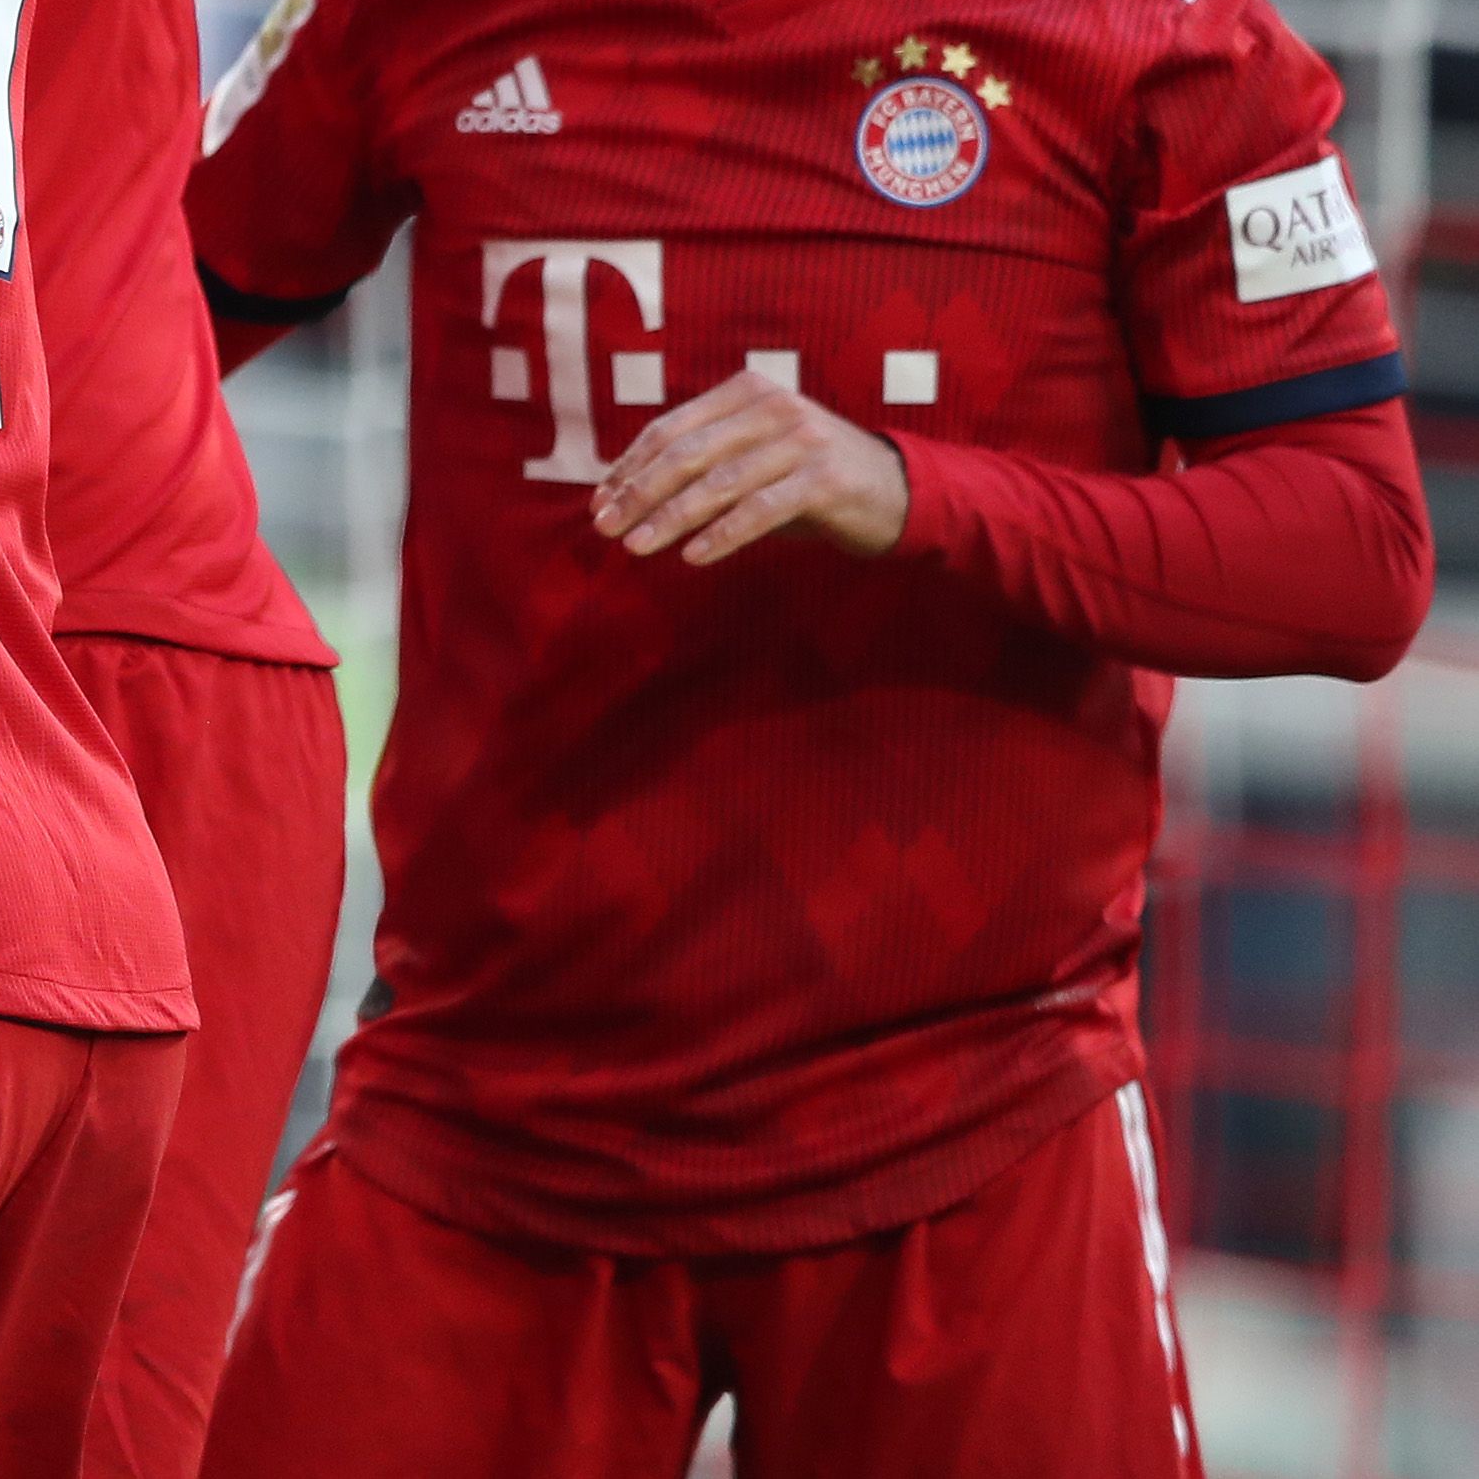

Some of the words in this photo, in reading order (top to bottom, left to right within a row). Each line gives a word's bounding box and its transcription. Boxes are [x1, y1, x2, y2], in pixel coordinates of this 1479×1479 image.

[455, 107, 562, 135] adidas
[871, 99, 899, 128] FC
[901, 87, 979, 140] BAYERN
[866, 147, 970, 200] MÜNCHEN
